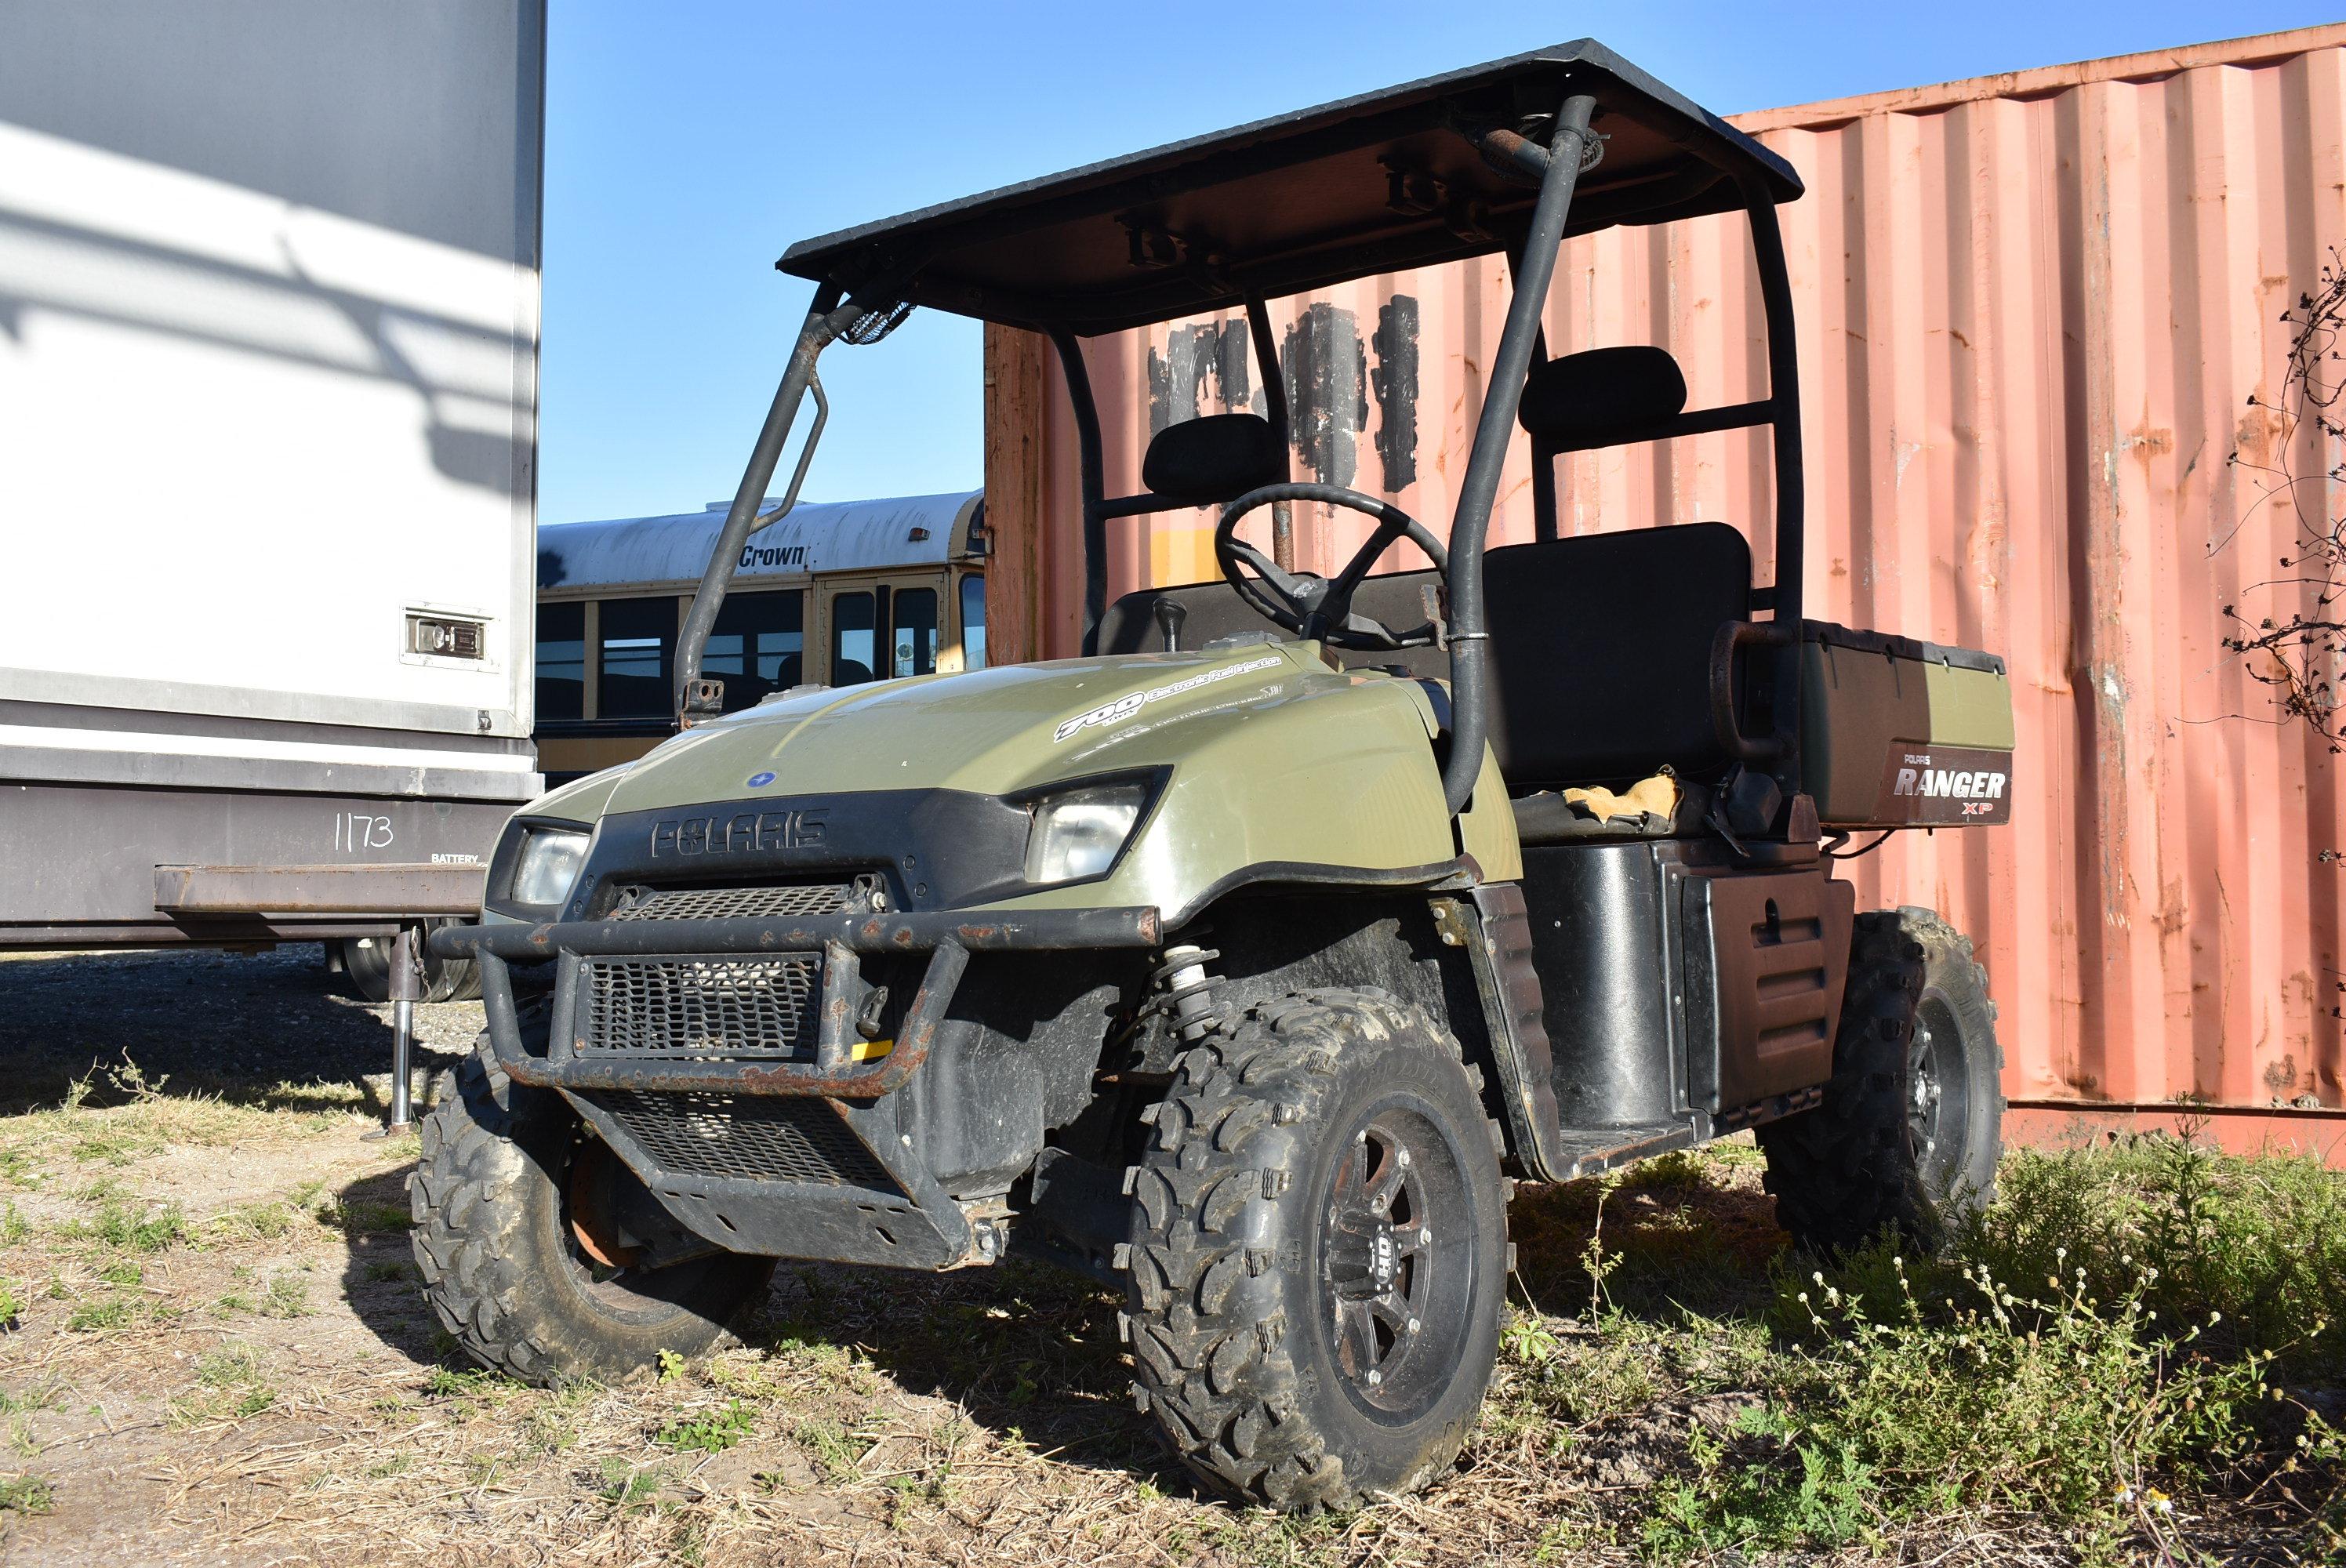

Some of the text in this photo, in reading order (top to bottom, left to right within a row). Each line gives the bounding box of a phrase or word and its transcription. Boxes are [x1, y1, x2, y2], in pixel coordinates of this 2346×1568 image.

[739, 546, 804, 567] Crown
[1055, 692, 1145, 742] 700
[1148, 674, 1209, 702] Electronic
[1210, 667, 1235, 682] Fuel
[1236, 657, 1282, 674] Injection
[1904, 754, 1930, 765] POLARIS
[1894, 768, 2006, 798] RANGER
[1961, 802, 1994, 815] XP
[335, 812, 394, 852] 1173
[652, 808, 830, 858] POLARIS
[431, 853, 479, 863] BATTERY
